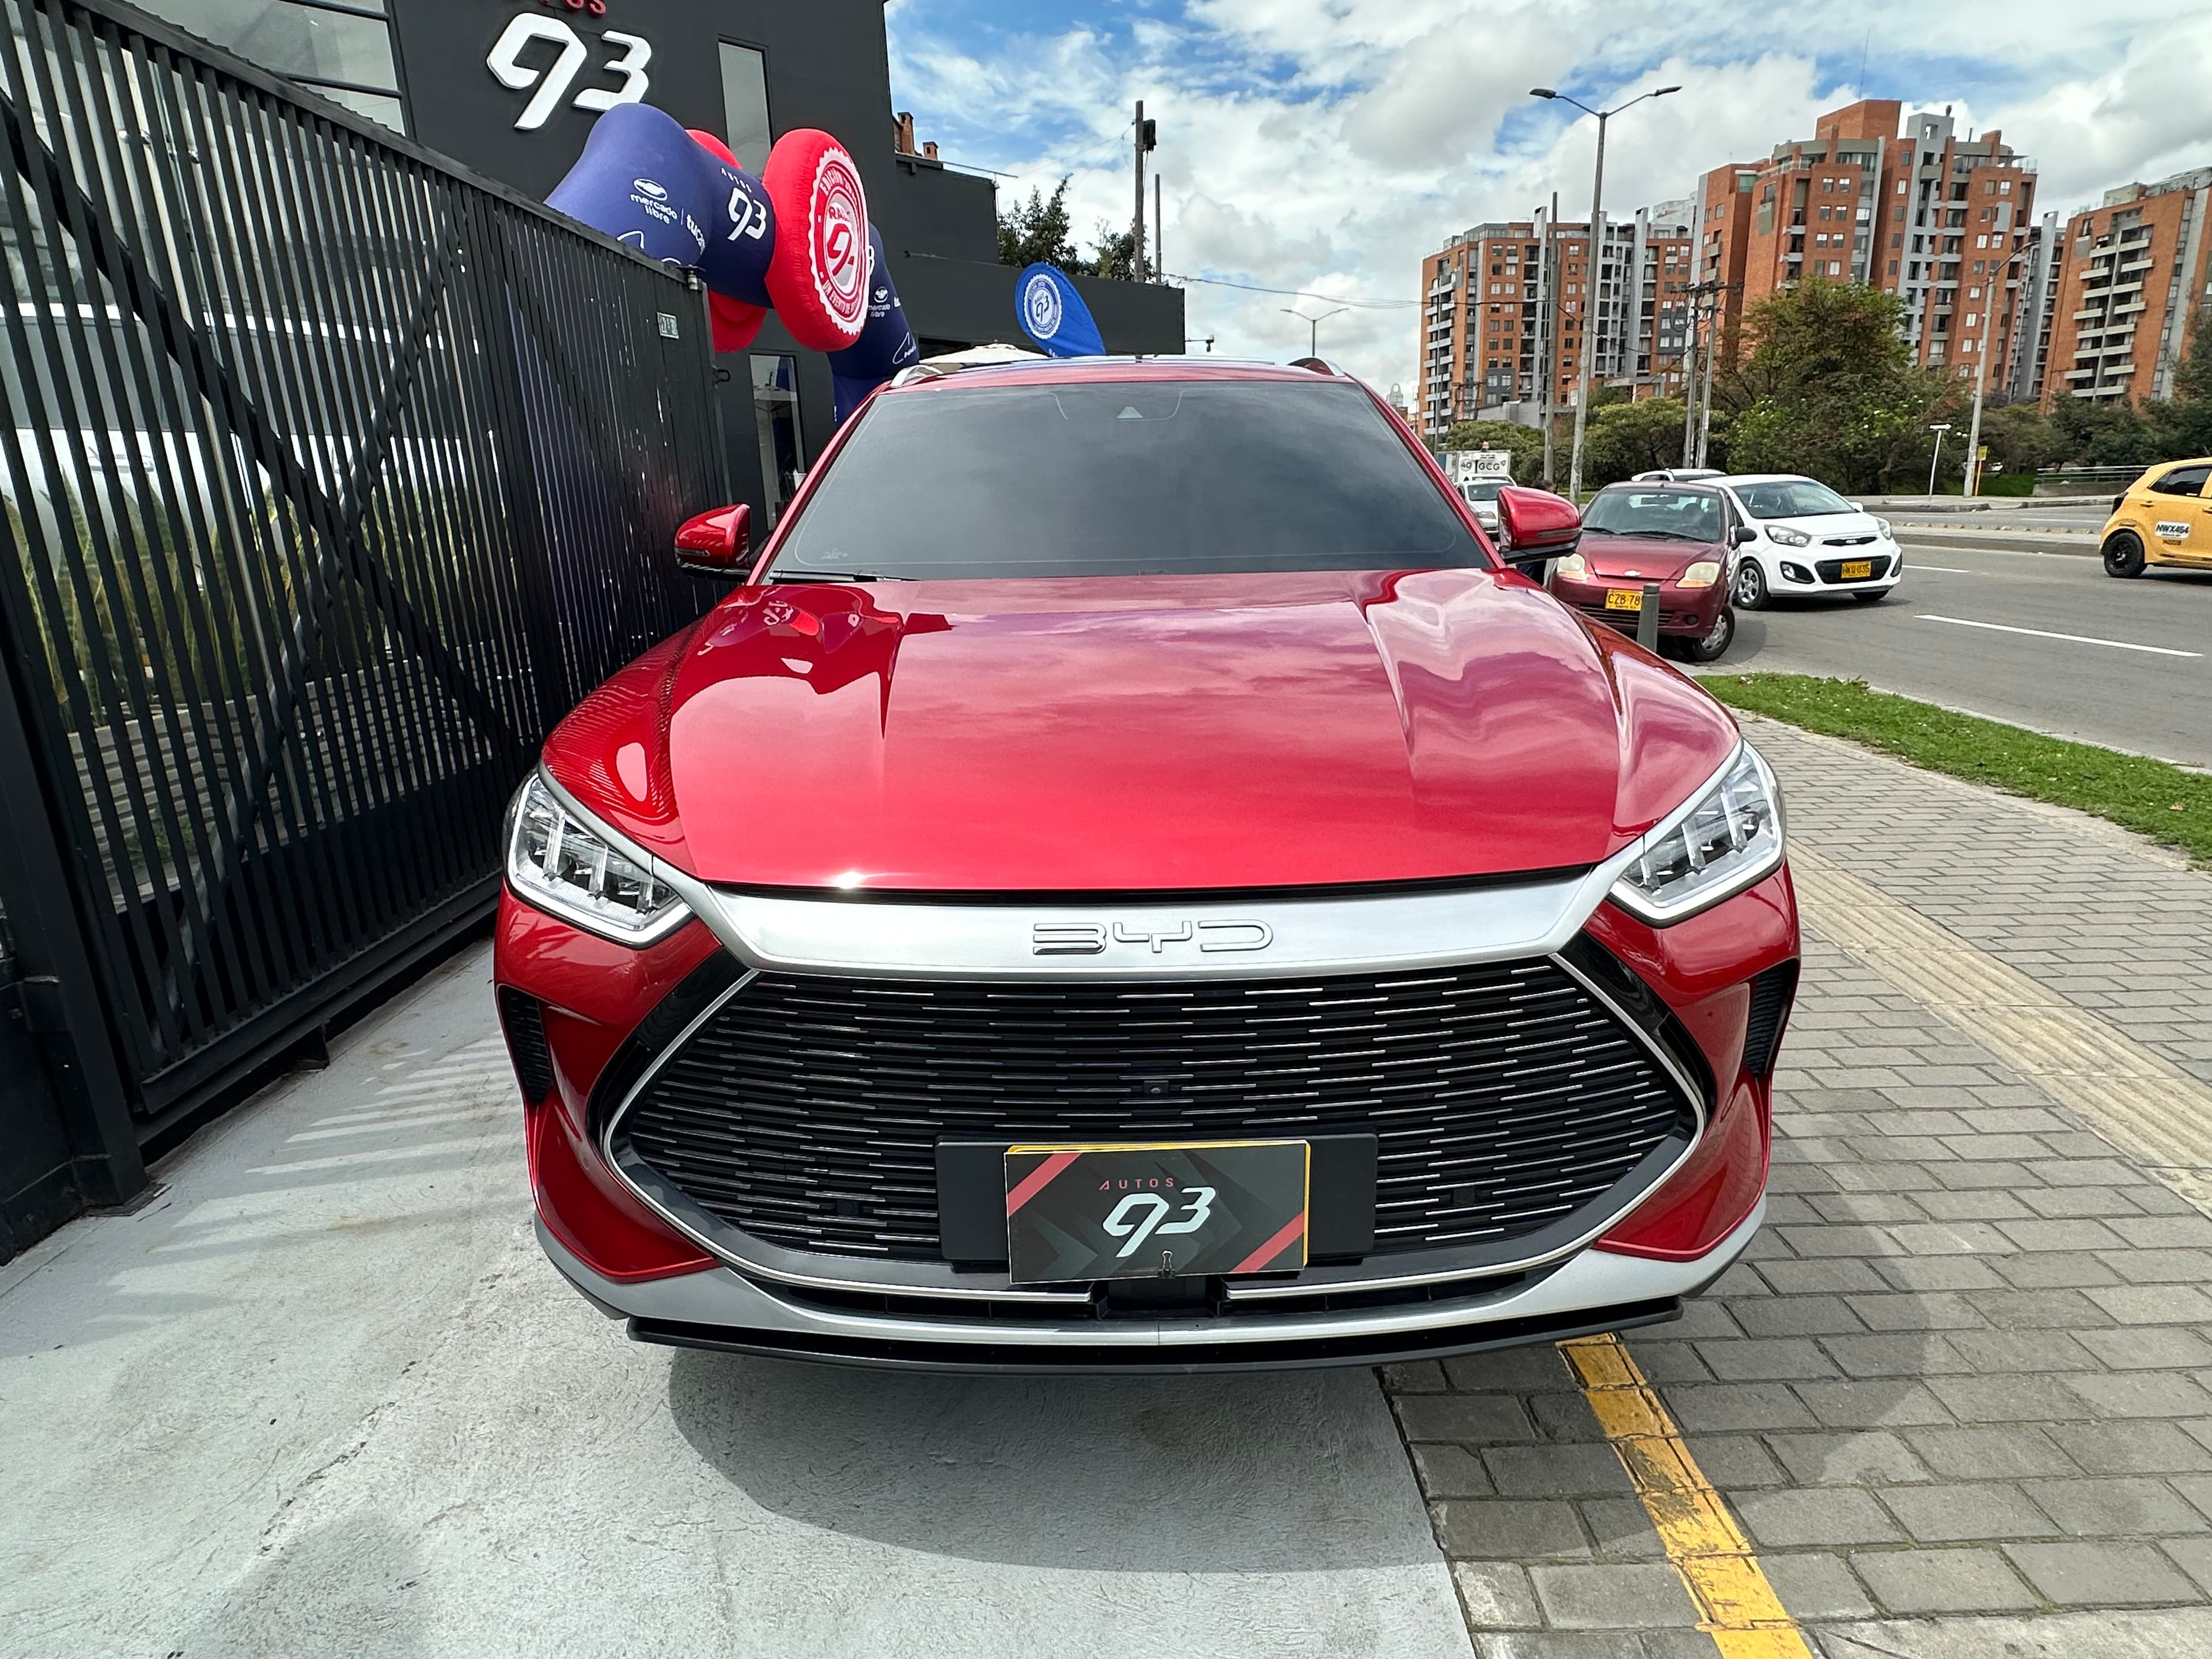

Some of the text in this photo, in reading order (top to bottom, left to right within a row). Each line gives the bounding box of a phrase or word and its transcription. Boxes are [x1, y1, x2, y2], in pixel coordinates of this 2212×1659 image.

[486, 13, 652, 130] 93
[630, 194, 678, 219] mercado
[645, 204, 670, 224] libre
[728, 187, 767, 241] 93
[1608, 593, 1626, 605] CZB
[1033, 919, 1274, 956] BYD
[1099, 1177, 1174, 1191] AUTOS
[1103, 1187, 1216, 1257] 93
